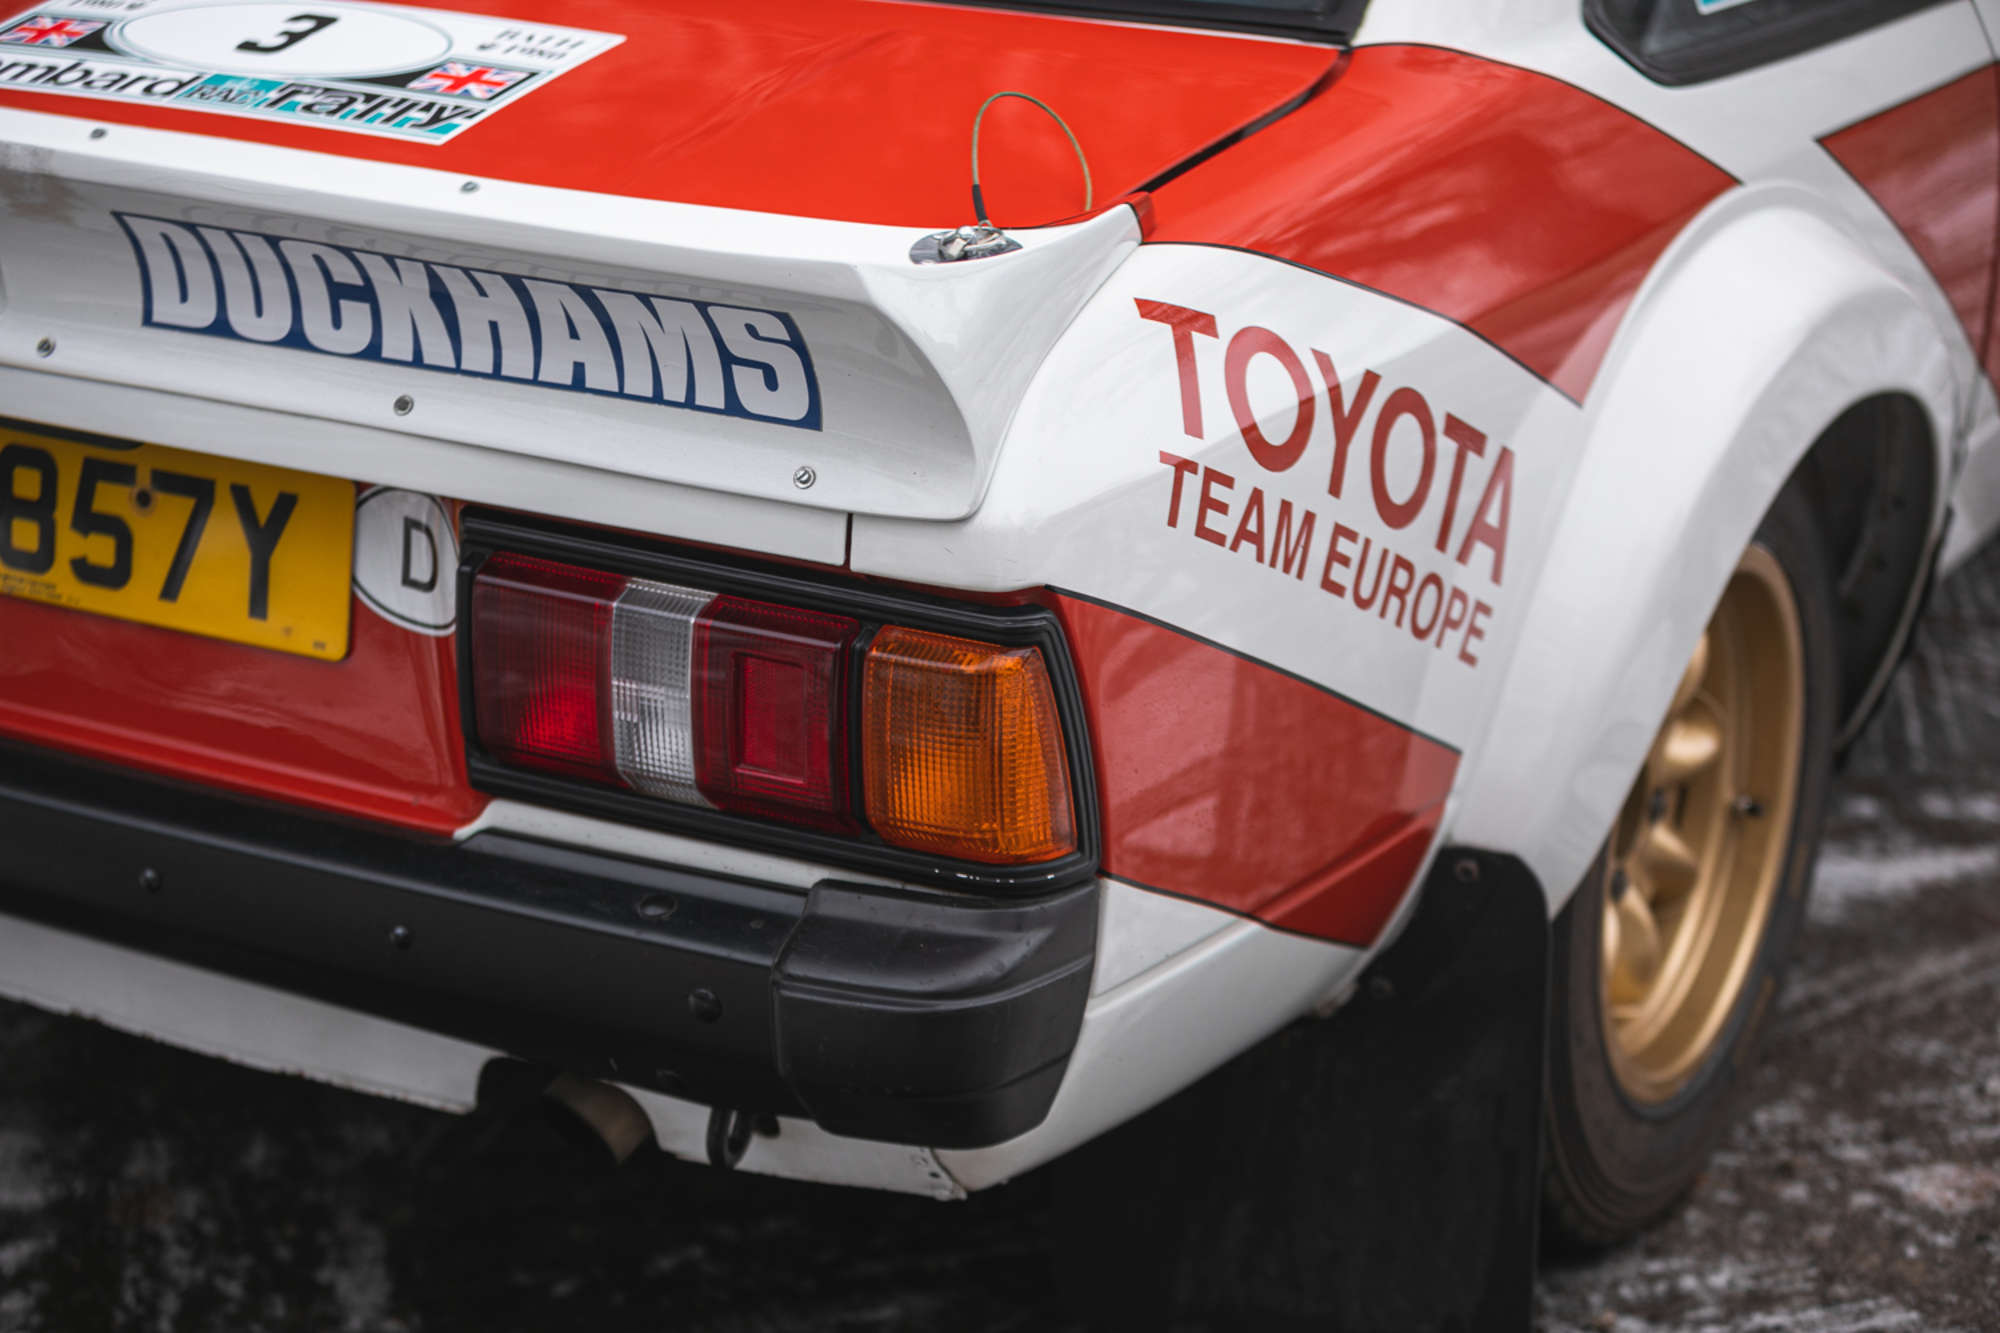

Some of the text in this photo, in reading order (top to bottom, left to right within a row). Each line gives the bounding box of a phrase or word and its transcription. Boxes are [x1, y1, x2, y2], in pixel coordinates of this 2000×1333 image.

[0, 59, 204, 97] mbard
[262, 82, 472, 130] rally
[235, 14, 340, 54] 3
[122, 214, 811, 422] DUCKHAMS
[1133, 297, 1515, 586] TOYOTA
[0, 443, 299, 621] 857Y
[402, 515, 438, 593] D
[1159, 450, 1493, 668] TEAM EUROPE
